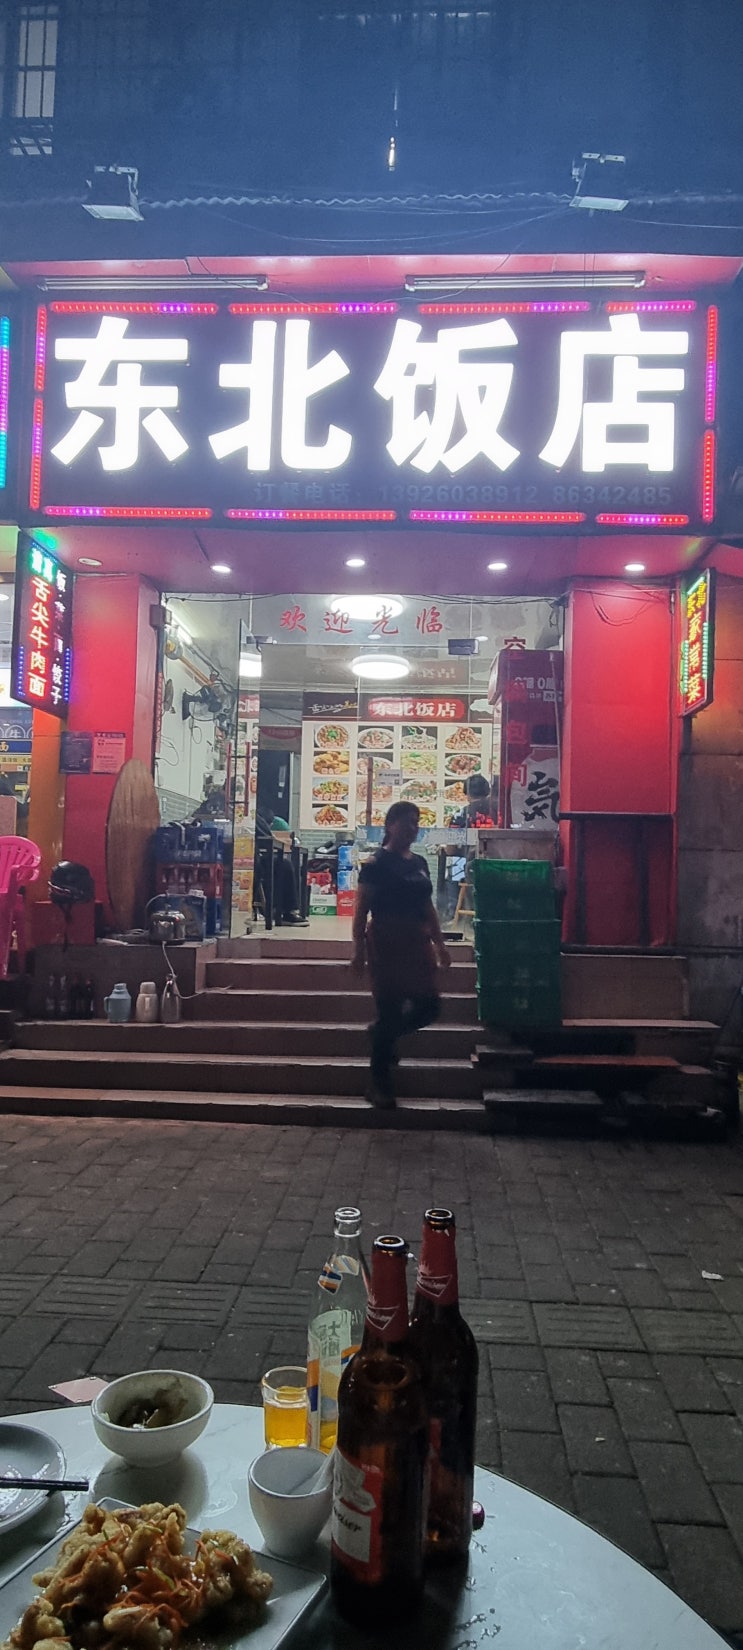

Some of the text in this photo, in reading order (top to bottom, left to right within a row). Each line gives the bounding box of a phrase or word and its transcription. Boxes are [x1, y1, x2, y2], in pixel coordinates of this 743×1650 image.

[51, 314, 690, 474] 东北饭店
[28, 576, 51, 698] 舌尖牛肉面
[280, 604, 444, 635] 欢迎光临
[373, 702, 457, 718] 东北饭店
